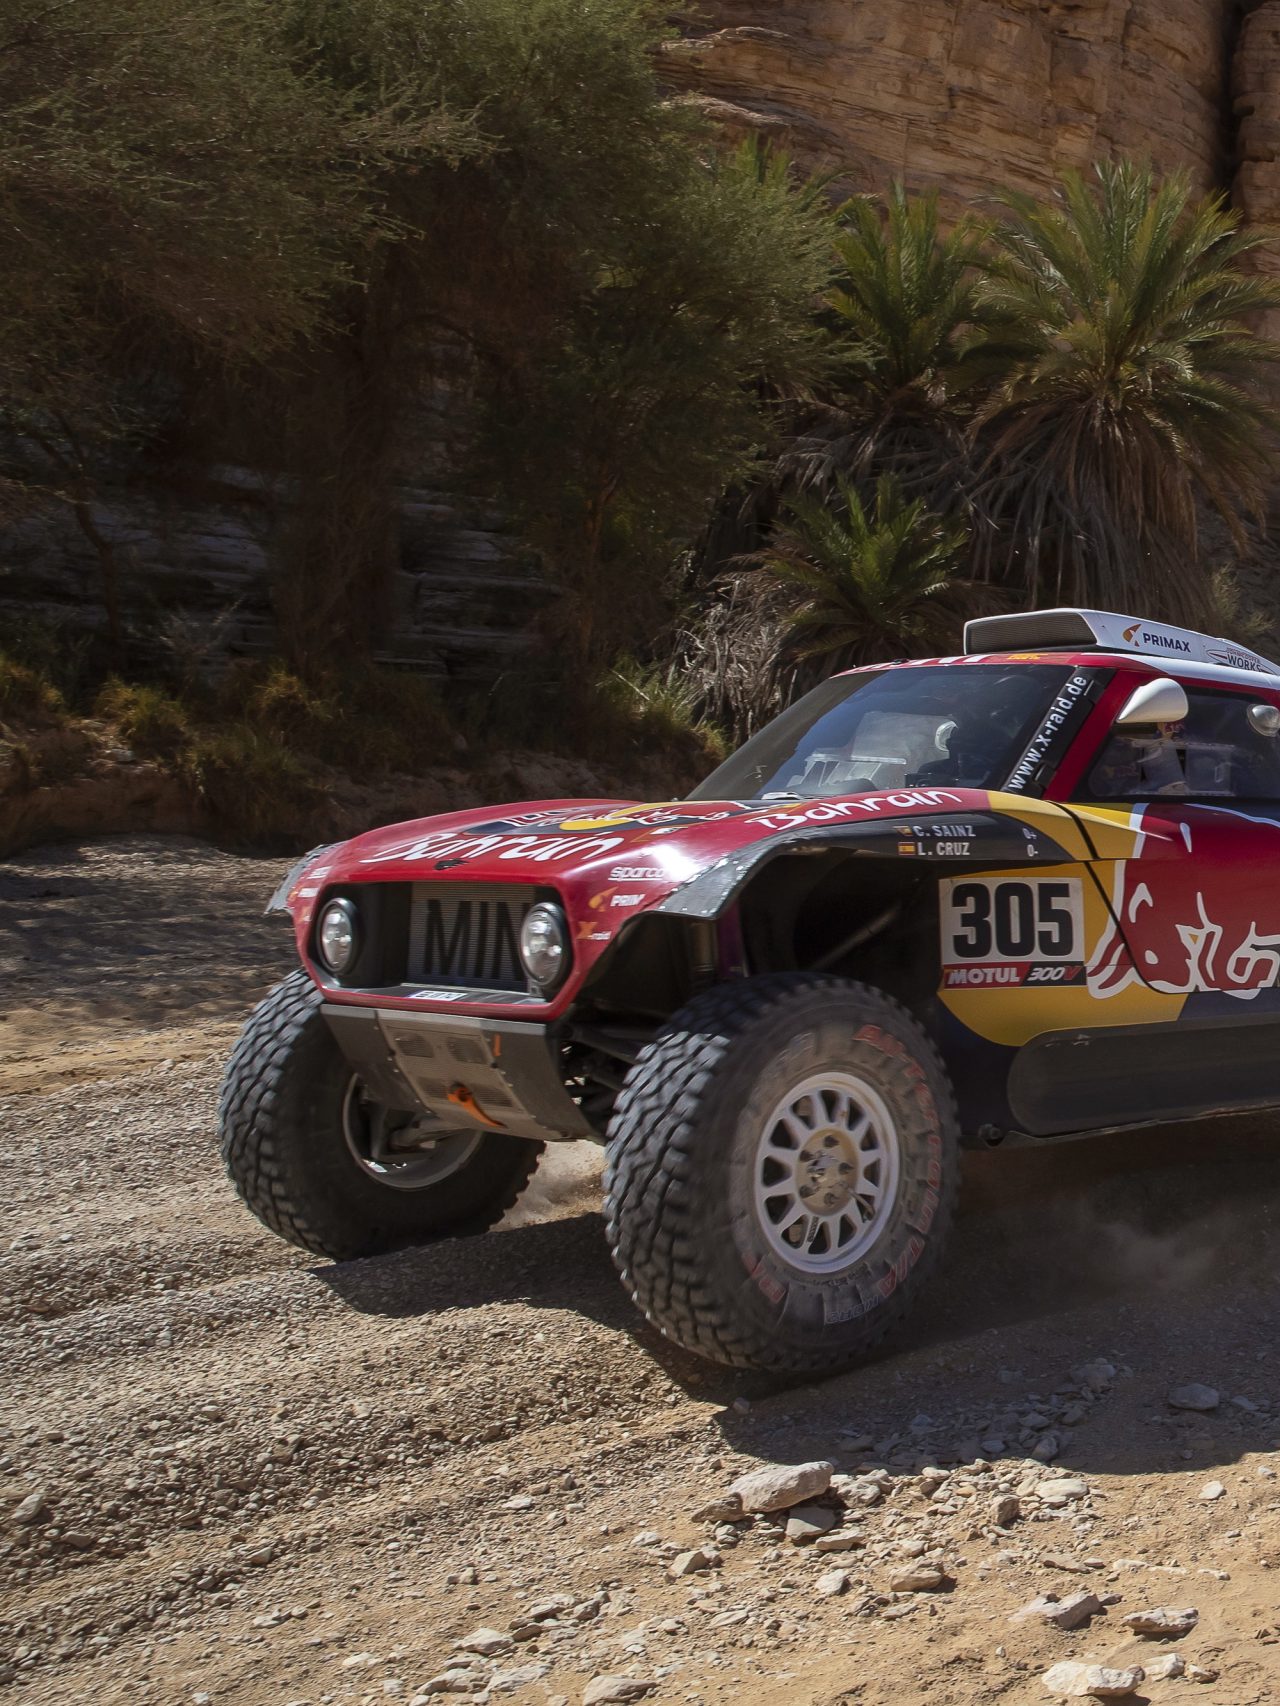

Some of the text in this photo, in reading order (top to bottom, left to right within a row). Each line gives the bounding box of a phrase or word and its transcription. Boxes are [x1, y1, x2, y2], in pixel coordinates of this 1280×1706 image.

[1142, 632, 1191, 653] PRIMAX
[1227, 653, 1261, 672] WORKS
[1008, 676, 1087, 789] www.x-raid.de
[744, 787, 963, 831] Bahrain
[912, 825, 976, 837] C. SAINZ
[358, 831, 625, 864] Bahrain
[917, 842, 970, 856] L. CRUZ
[952, 882, 1073, 958] 305
[948, 965, 1083, 985] MOTUL 300V
